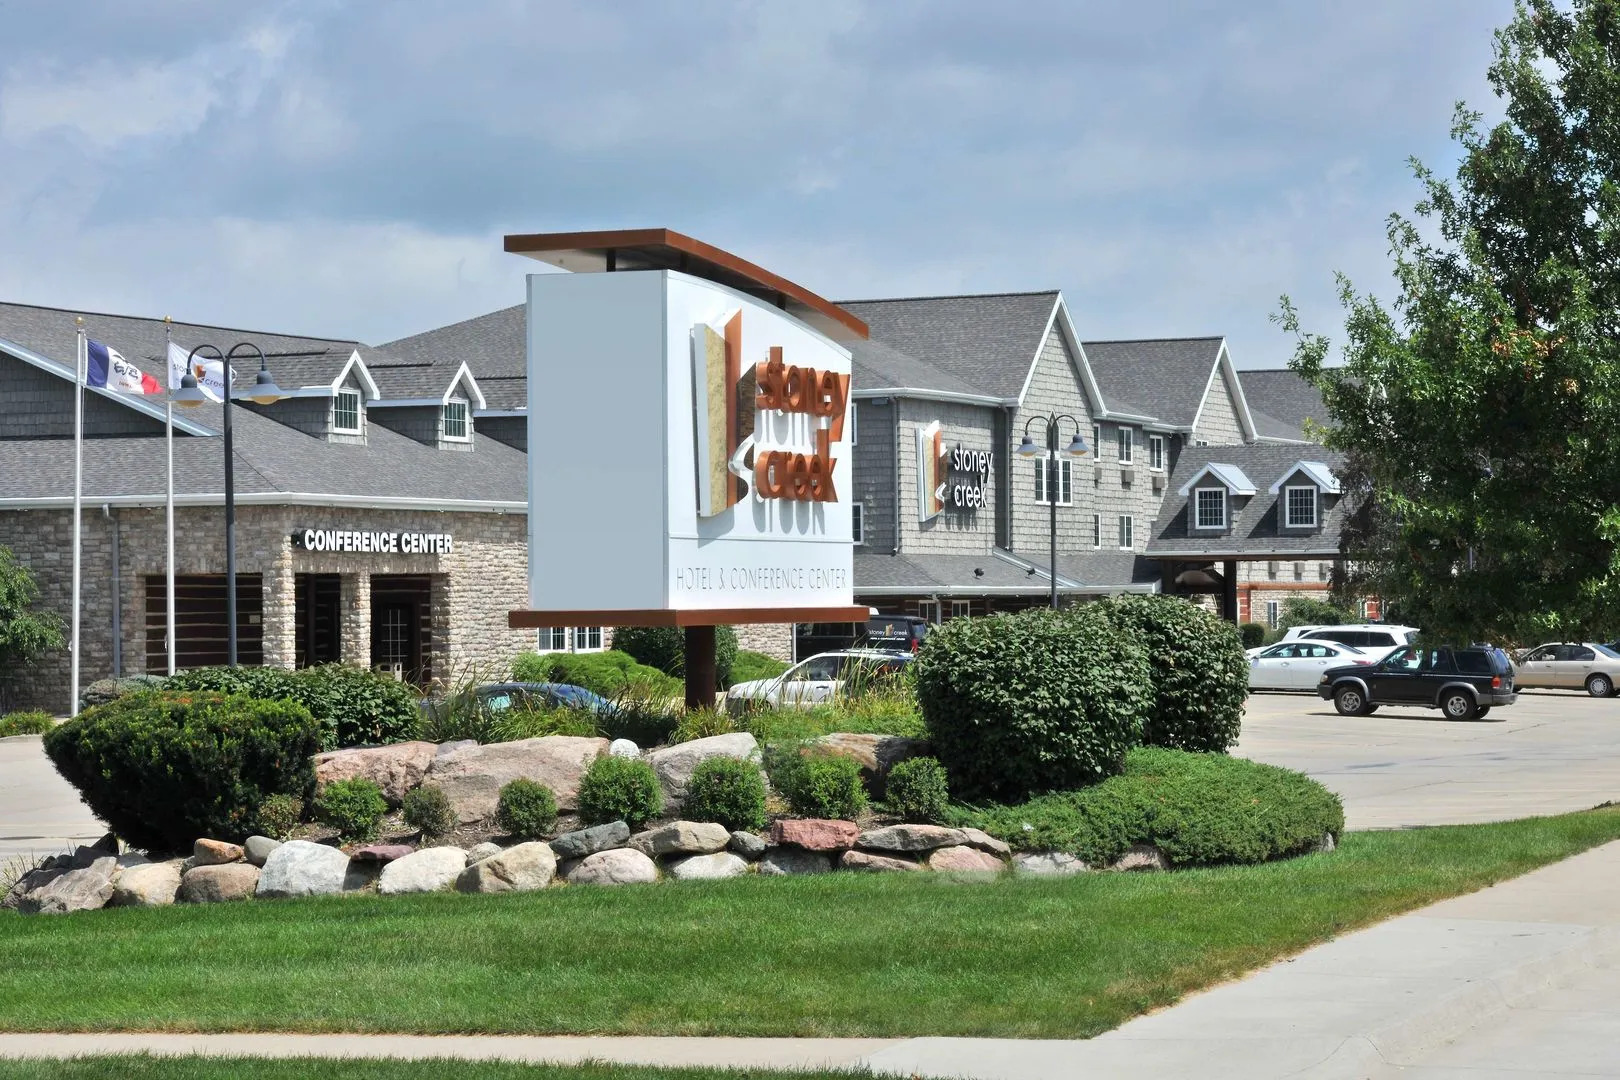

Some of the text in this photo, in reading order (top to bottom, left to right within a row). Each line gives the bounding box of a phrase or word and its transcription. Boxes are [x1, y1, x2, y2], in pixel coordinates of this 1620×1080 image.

[756, 346, 851, 442] stoney
[954, 442, 994, 483] stoney
[954, 474, 988, 508] creek
[304, 529, 453, 554] CONFERENCE CENTER
[676, 567, 847, 590] HOTEL & CONFERENCE CENTER
